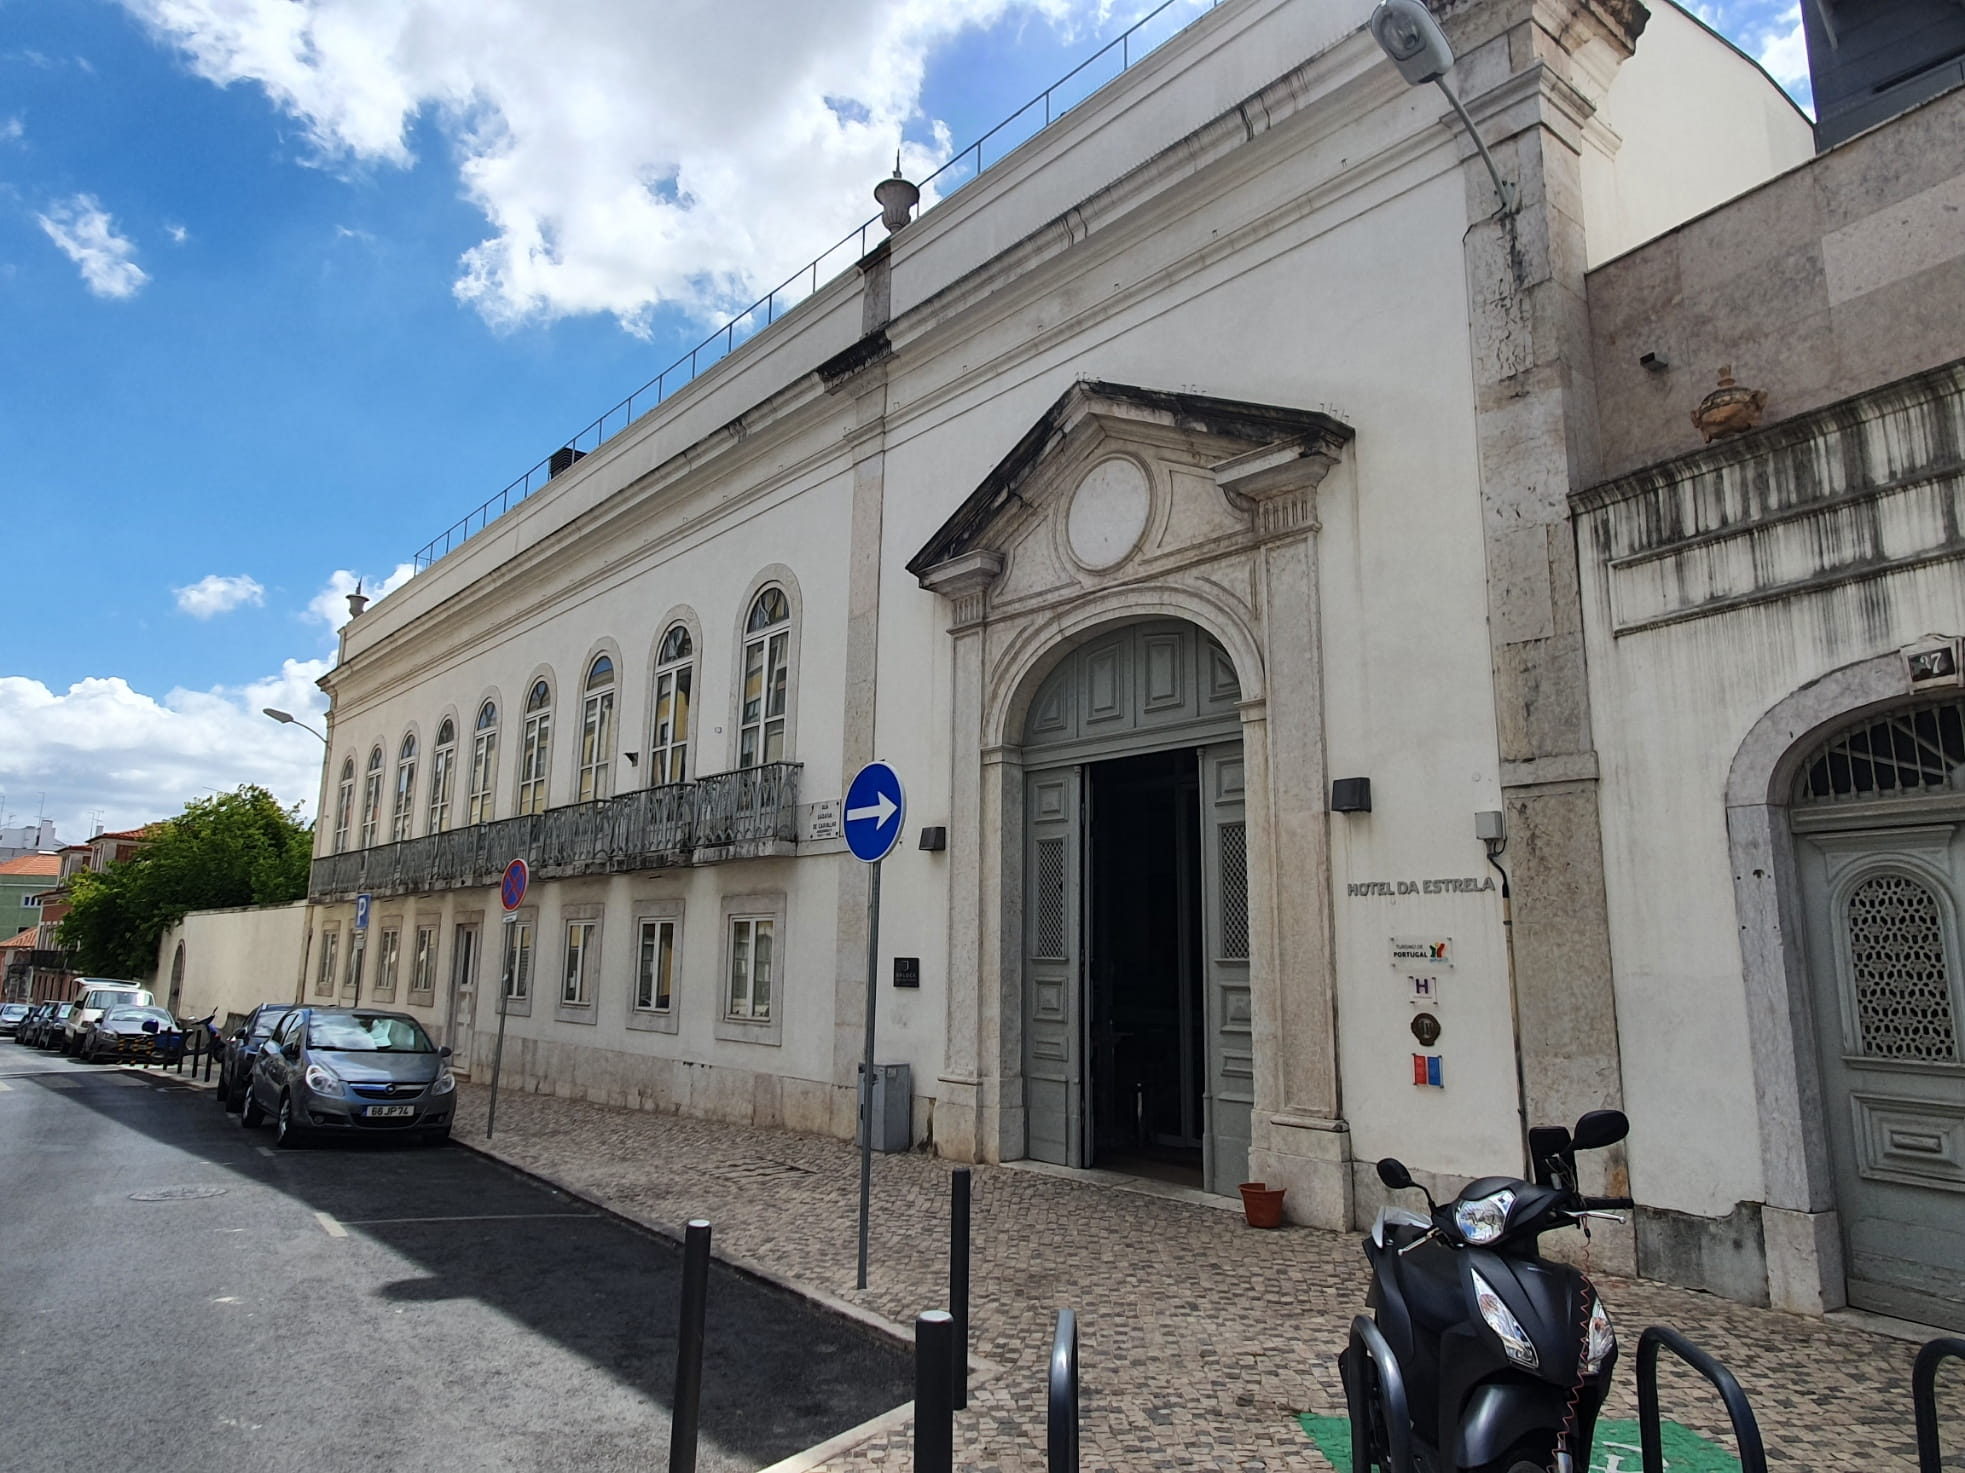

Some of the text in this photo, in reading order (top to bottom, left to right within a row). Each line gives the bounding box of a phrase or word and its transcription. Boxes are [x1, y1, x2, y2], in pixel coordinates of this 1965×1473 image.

[1347, 877, 1496, 896] HOTEL DA ESTRELA
[356, 897, 367, 926] P
[1415, 978, 1429, 994] H
